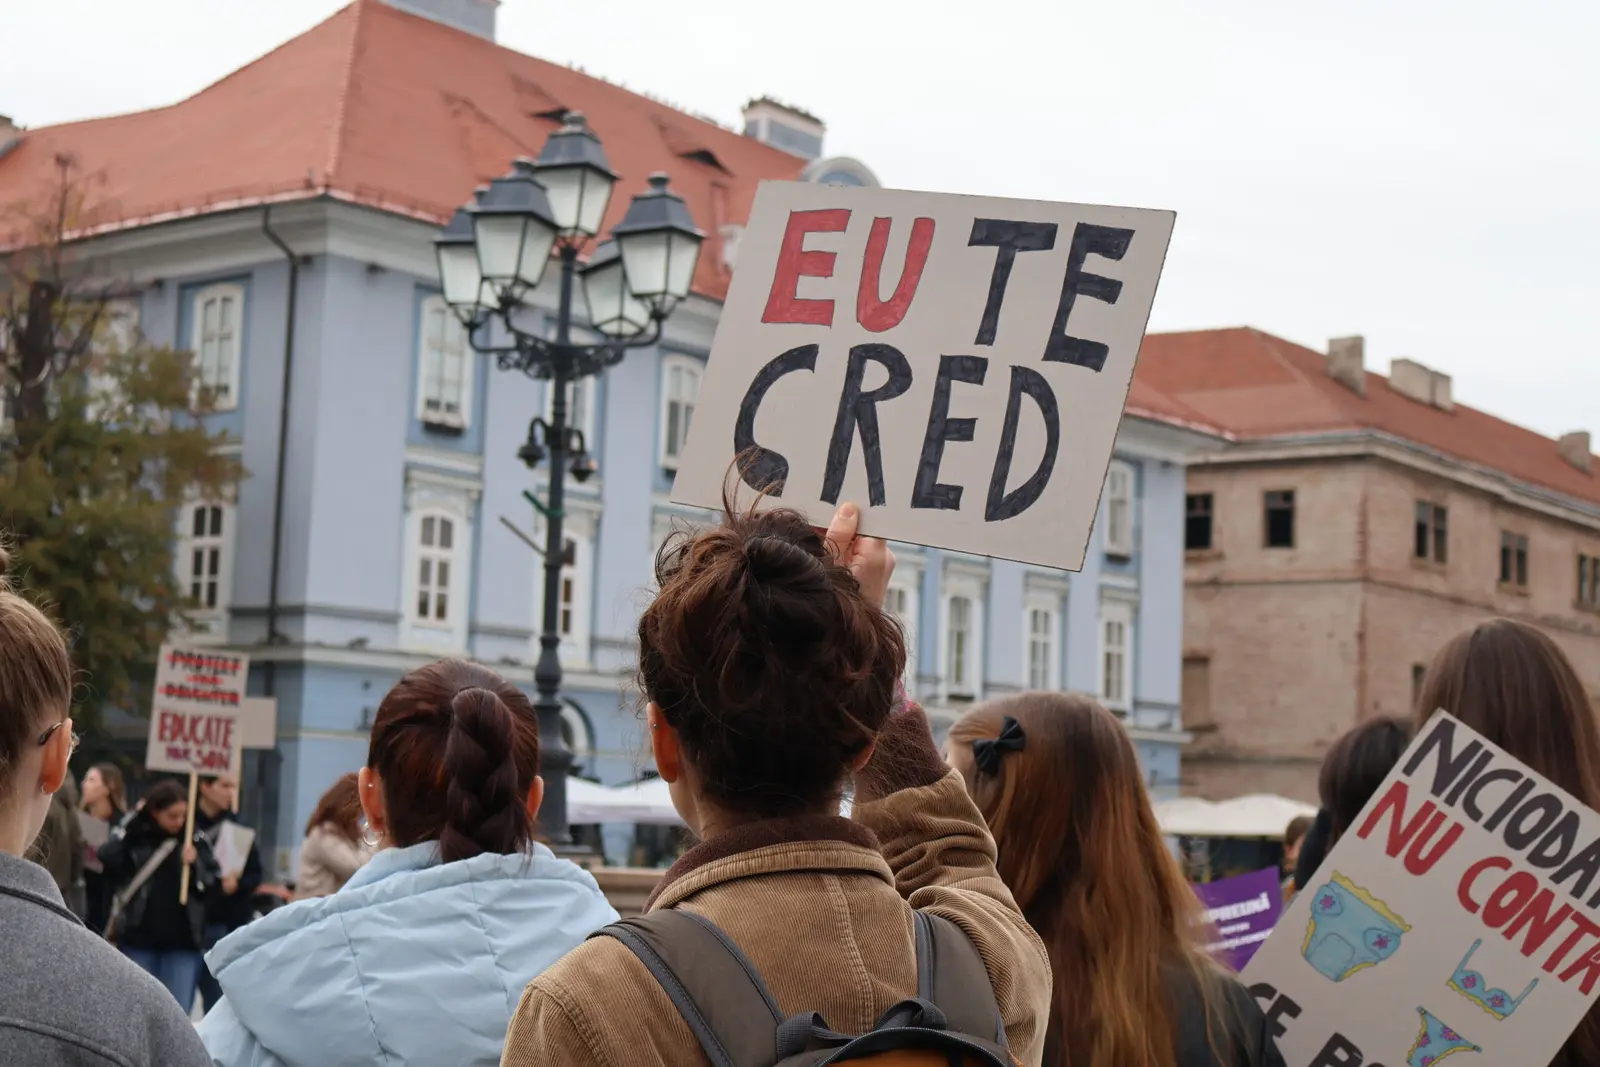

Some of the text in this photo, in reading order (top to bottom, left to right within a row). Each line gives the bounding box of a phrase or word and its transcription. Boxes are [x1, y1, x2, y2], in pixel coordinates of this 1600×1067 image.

[761, 209, 1136, 373] EU TE
[734, 343, 1060, 522] CRED
[158, 711, 235, 749] EDUCATE
[1356, 780, 1464, 876] NU
[1402, 718, 1600, 909] NICIODA
